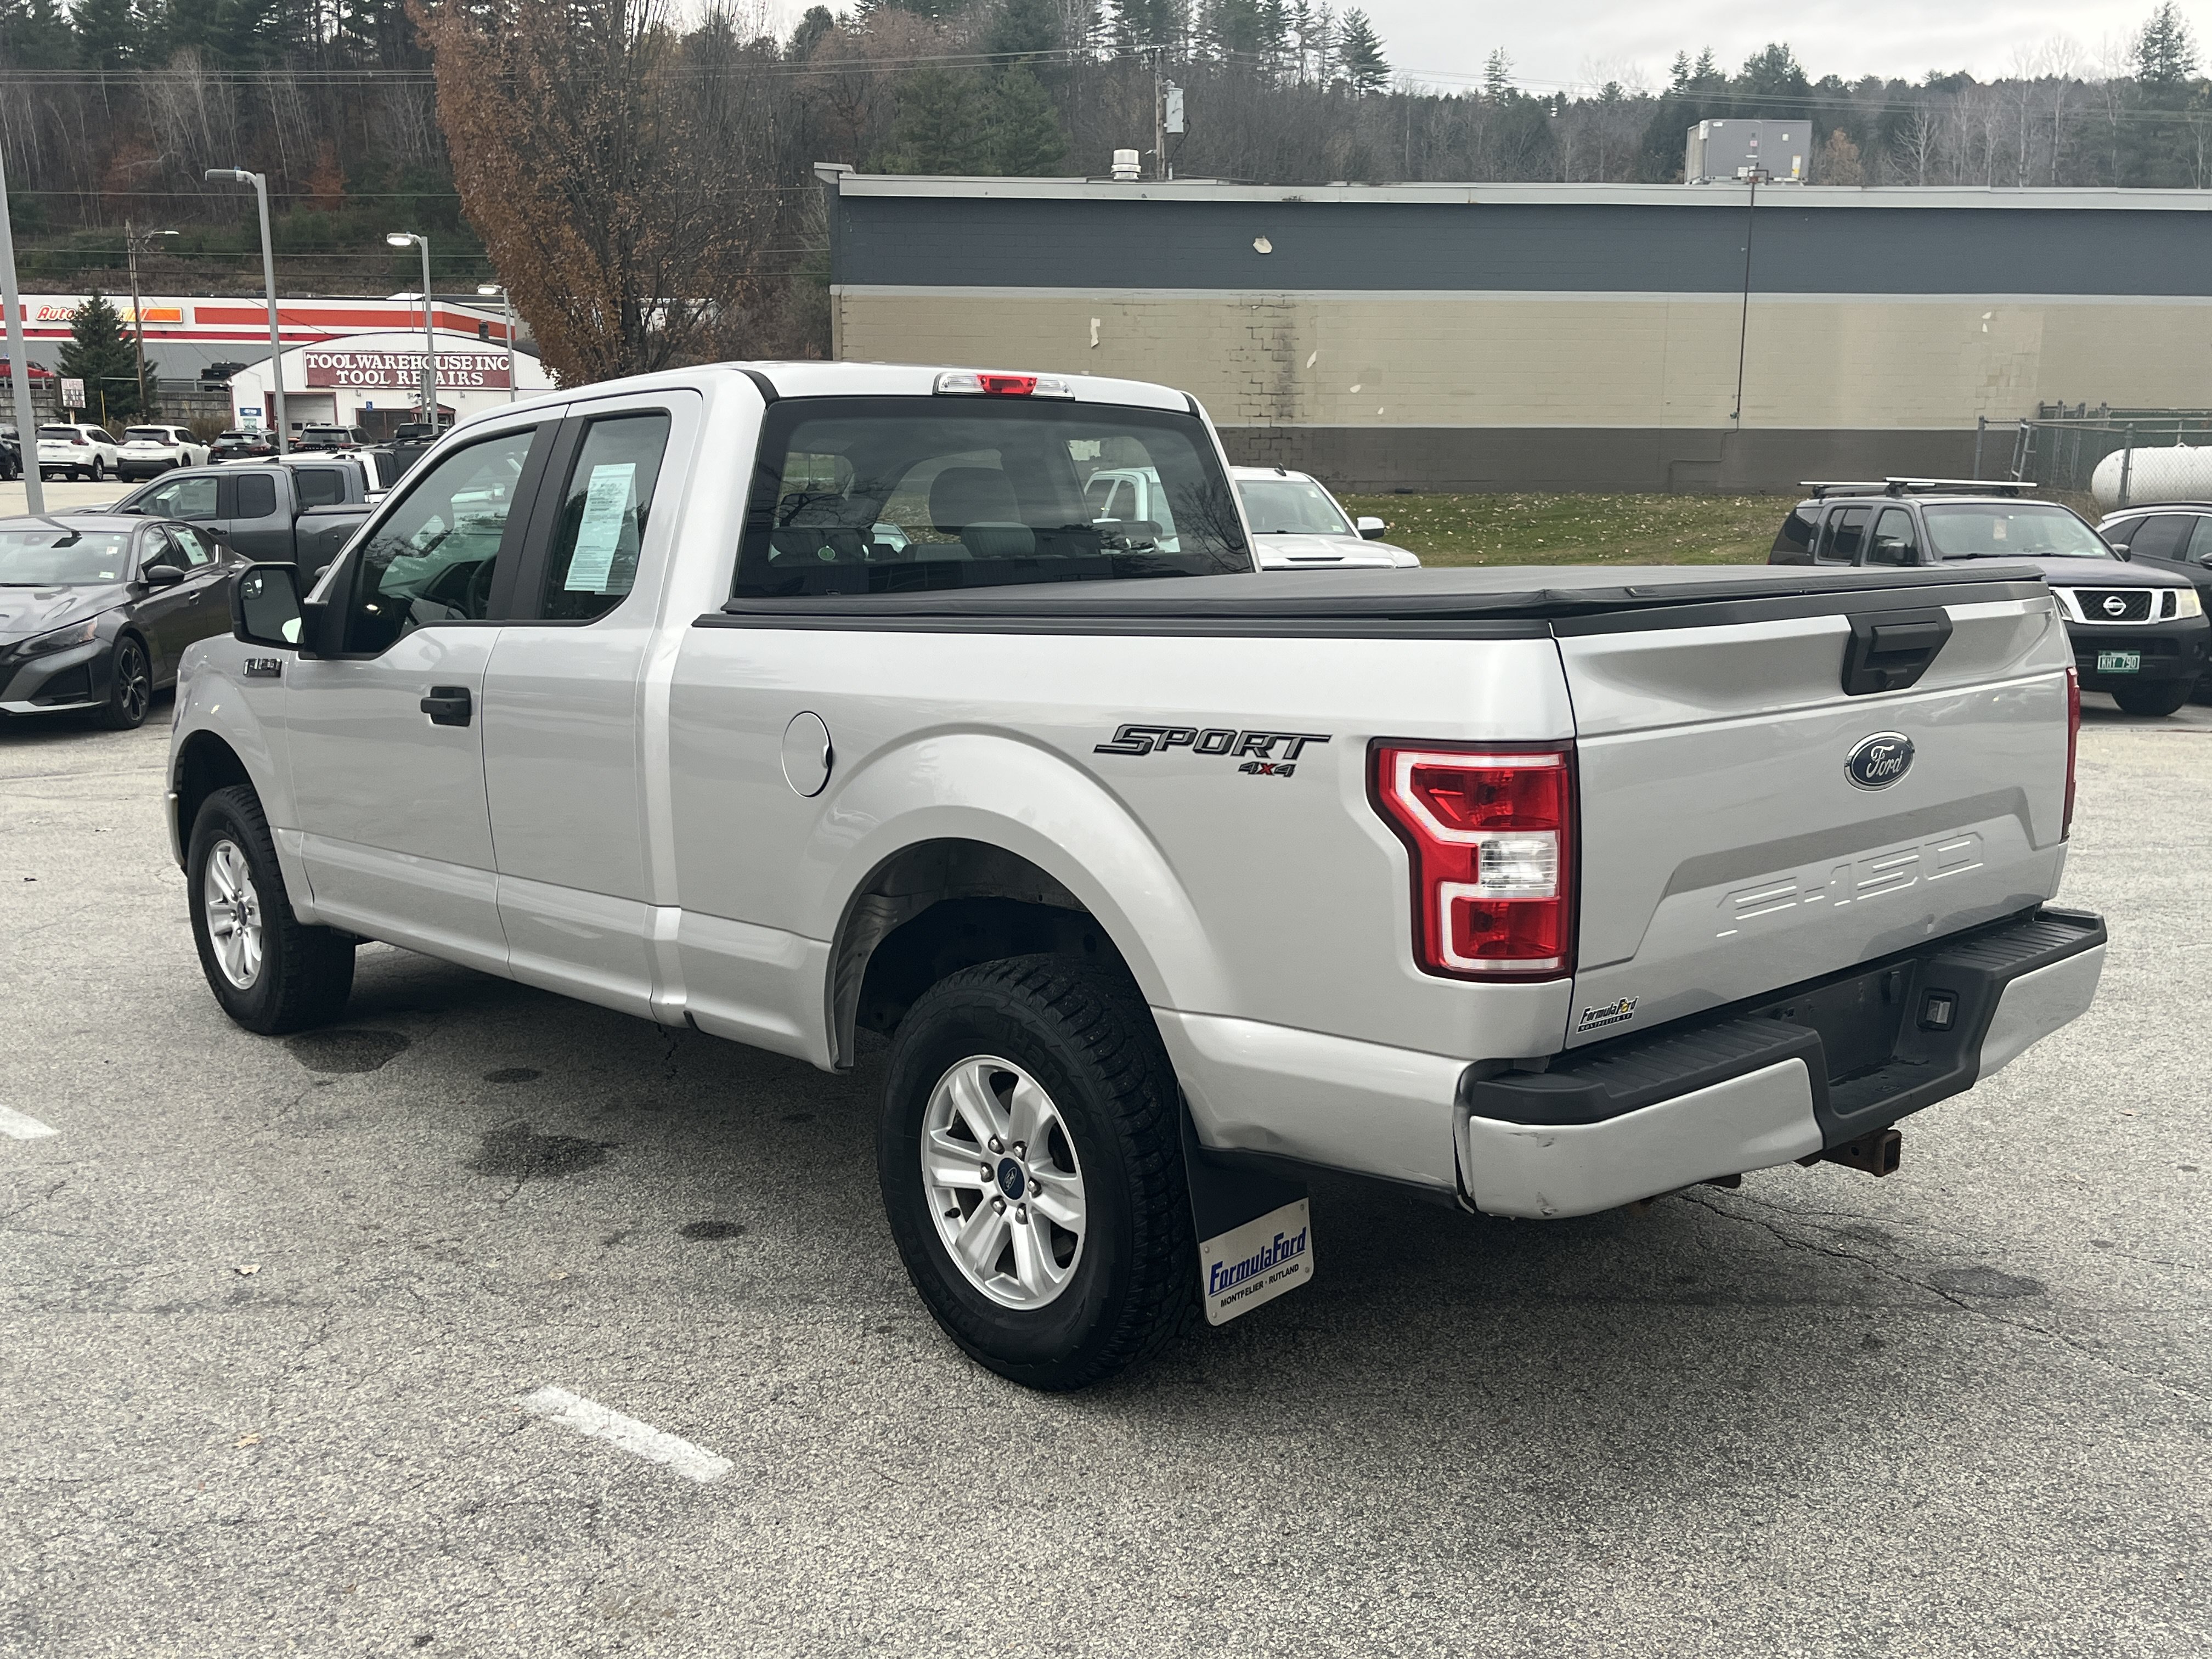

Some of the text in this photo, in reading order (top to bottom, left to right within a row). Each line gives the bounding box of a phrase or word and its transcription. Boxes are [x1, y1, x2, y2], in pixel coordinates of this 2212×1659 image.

[336, 370, 484, 385] TOOL REAIRS
[475, 356, 510, 370] INC
[1093, 723, 1334, 761] SPORT
[1866, 744, 1904, 778] Ford
[1716, 831, 1984, 938] F-150
[1220, 1263, 1299, 1308] MONTPELIER RUTLAND
